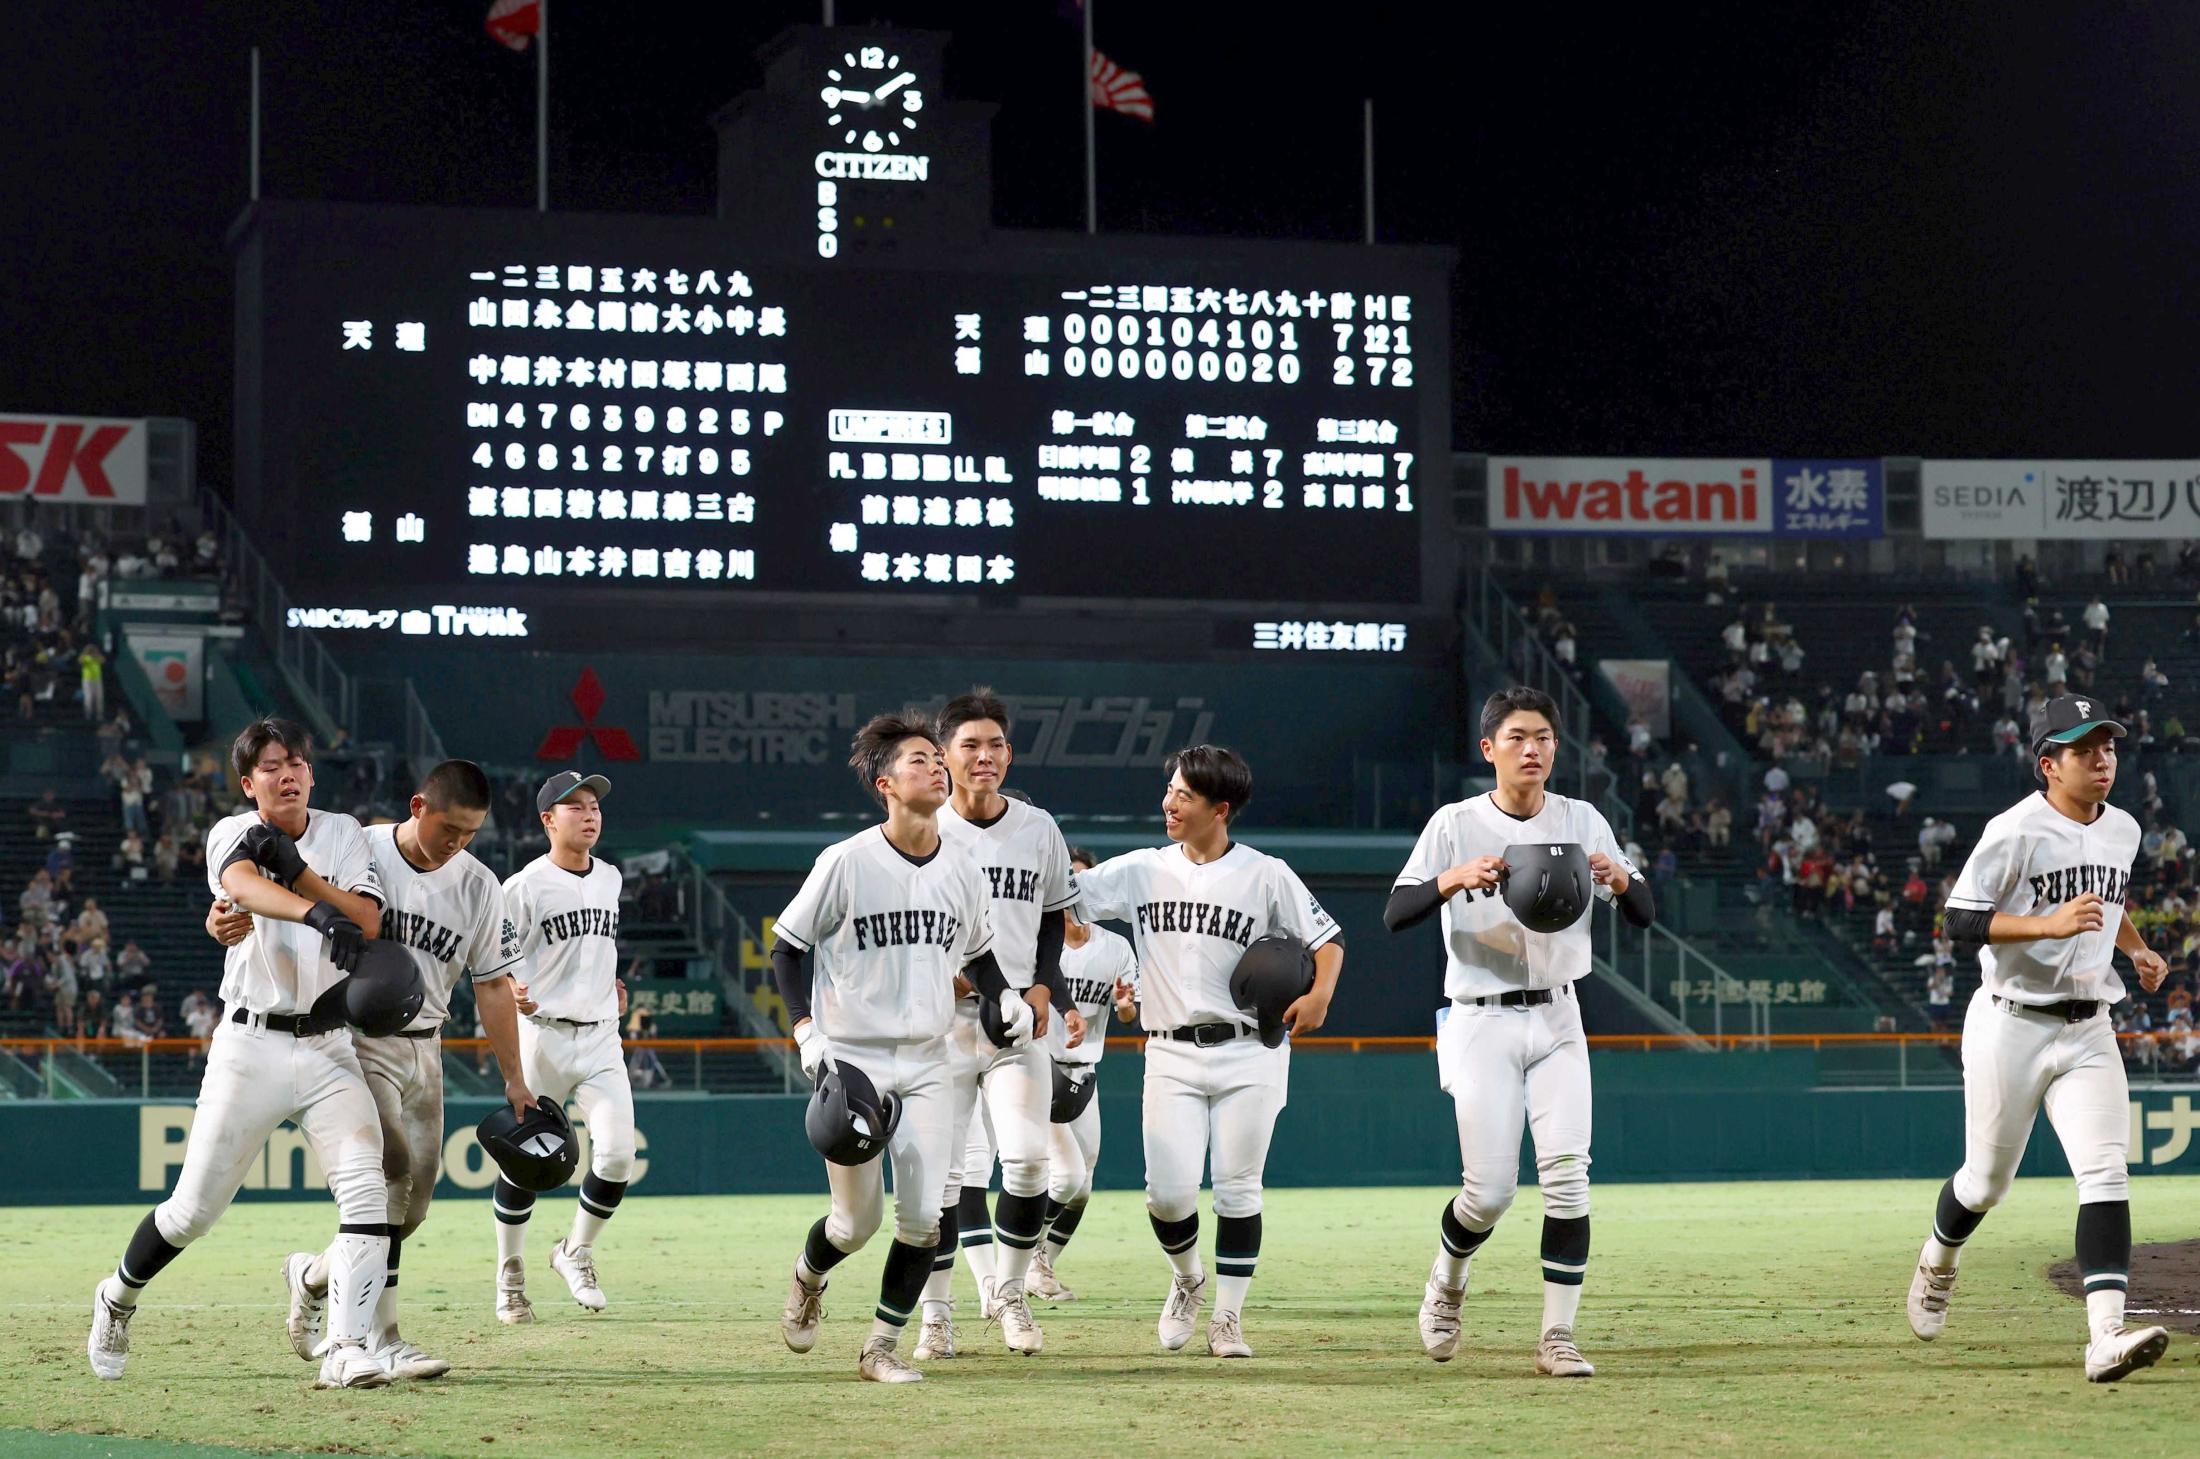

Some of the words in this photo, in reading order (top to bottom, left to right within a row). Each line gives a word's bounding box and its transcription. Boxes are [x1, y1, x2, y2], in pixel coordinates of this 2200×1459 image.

[861, 47, 884, 69] 12
[815, 152, 929, 181] CITIZEN
[1365, 295, 1386, 320] H
[1333, 324, 1353, 352] 7
[1333, 356, 1354, 385] 2
[1130, 445, 1150, 473] 2
[1263, 449, 1282, 477] 7
[1393, 453, 1413, 480] 7
[1132, 477, 1150, 505] 1
[1263, 480, 1283, 508] 2
[1395, 484, 1413, 511] 1
[1504, 467, 1757, 521] Iwatani
[1785, 468, 1869, 510] 水素
[1786, 513, 1869, 531] エネルギー
[1253, 621, 1407, 652] 三井住友銀行
[650, 691, 856, 728] MITSUBISHI
[2075, 700, 2091, 719] F
[651, 727, 828, 763] ELECTRIC
[1137, 901, 1255, 947] FUKUYAMA
